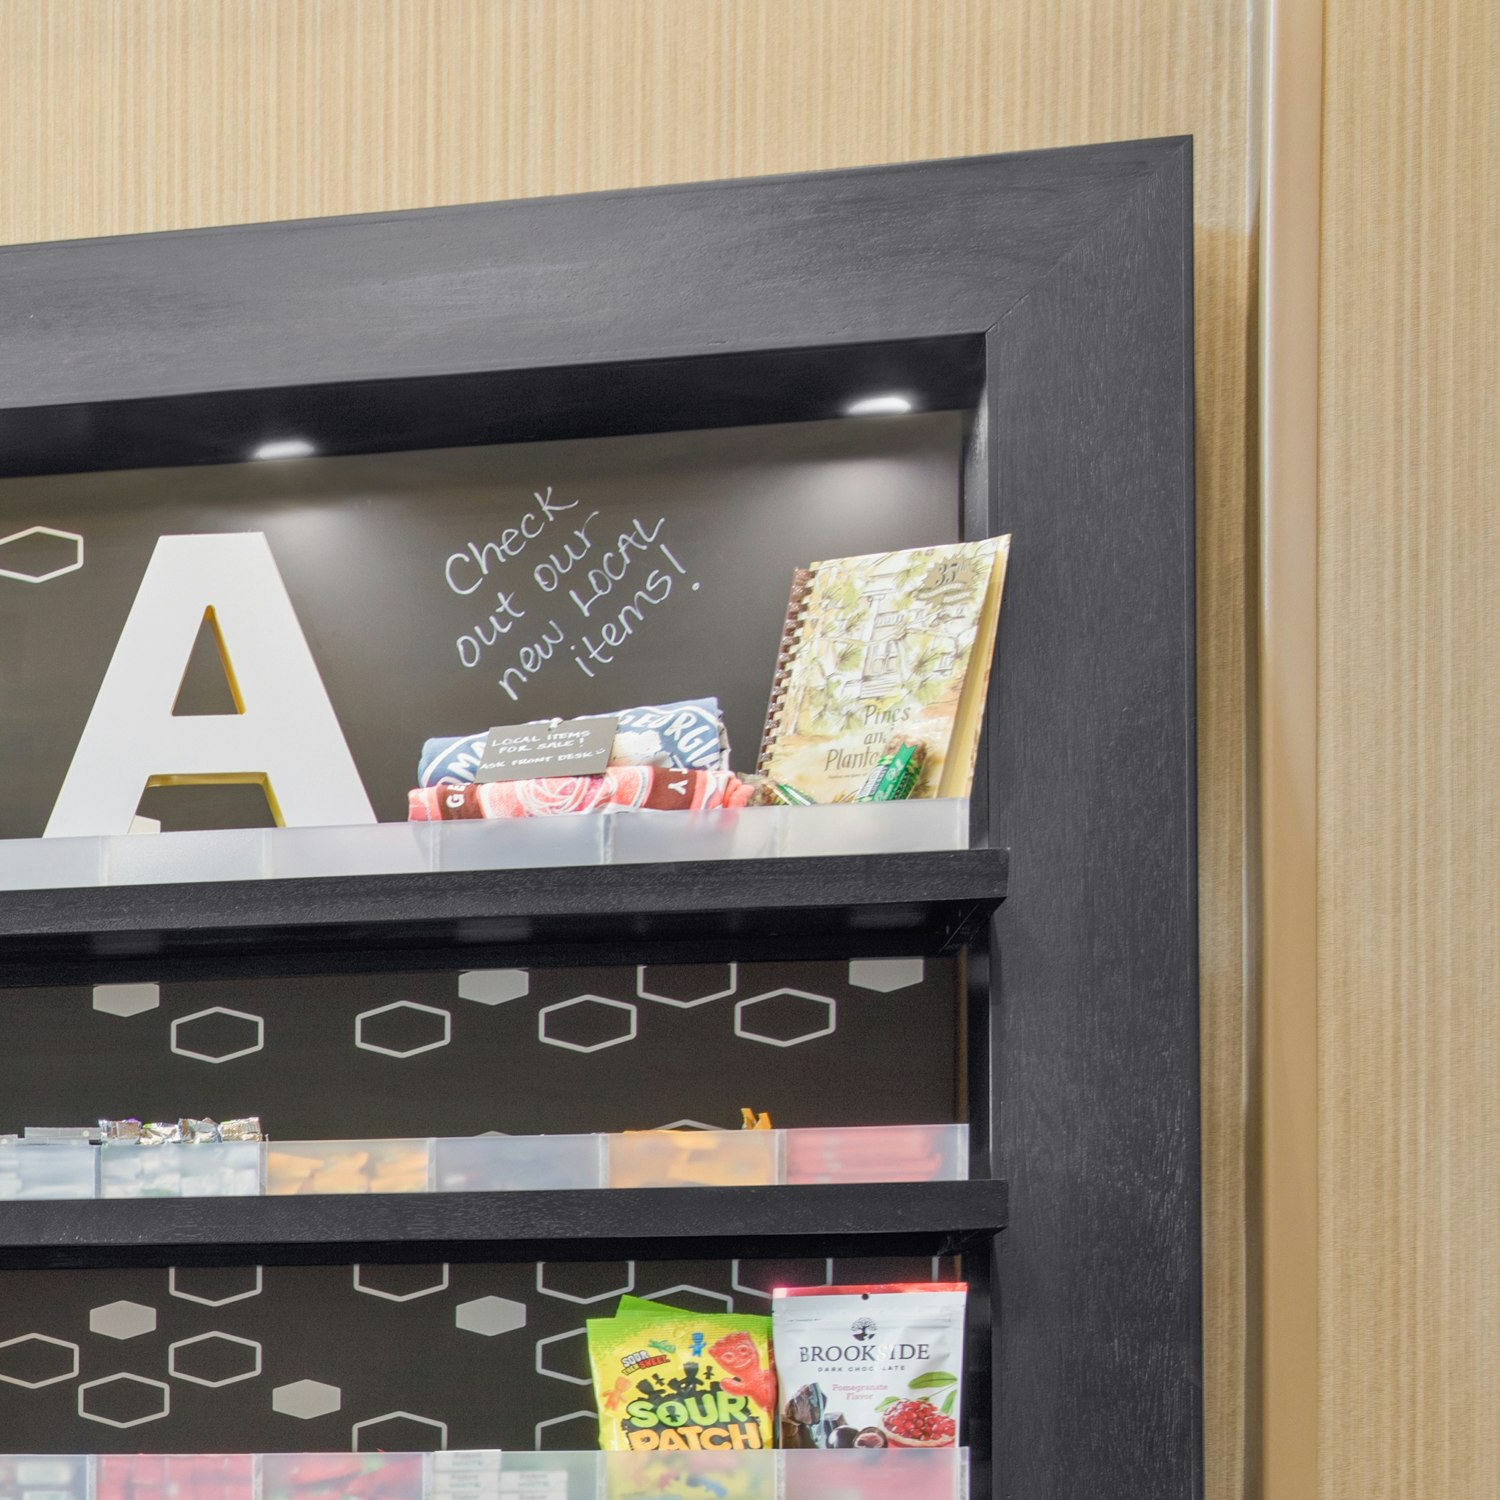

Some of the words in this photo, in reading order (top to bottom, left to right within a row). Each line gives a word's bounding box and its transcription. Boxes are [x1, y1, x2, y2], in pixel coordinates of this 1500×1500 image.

[445, 486, 579, 595] Check
[456, 592, 526, 668] out
[533, 511, 600, 592] our
[570, 543, 702, 678] items!
[498, 620, 565, 701] new
[492, 735, 541, 748] LOCAL
[546, 728, 591, 742] ITEMS
[498, 742, 535, 754] FOR
[479, 760, 506, 771] ASK
[511, 755, 554, 768] FRONT
[557, 751, 594, 762] DESK
[621, 1349, 649, 1366] SOUR
[817, 1365, 844, 1373] DARK
[832, 1383, 889, 1395] Pomegranate
[845, 1391, 874, 1401] Flavor
[628, 1391, 750, 1428] SOUR
[627, 1422, 762, 1450] PATCH
